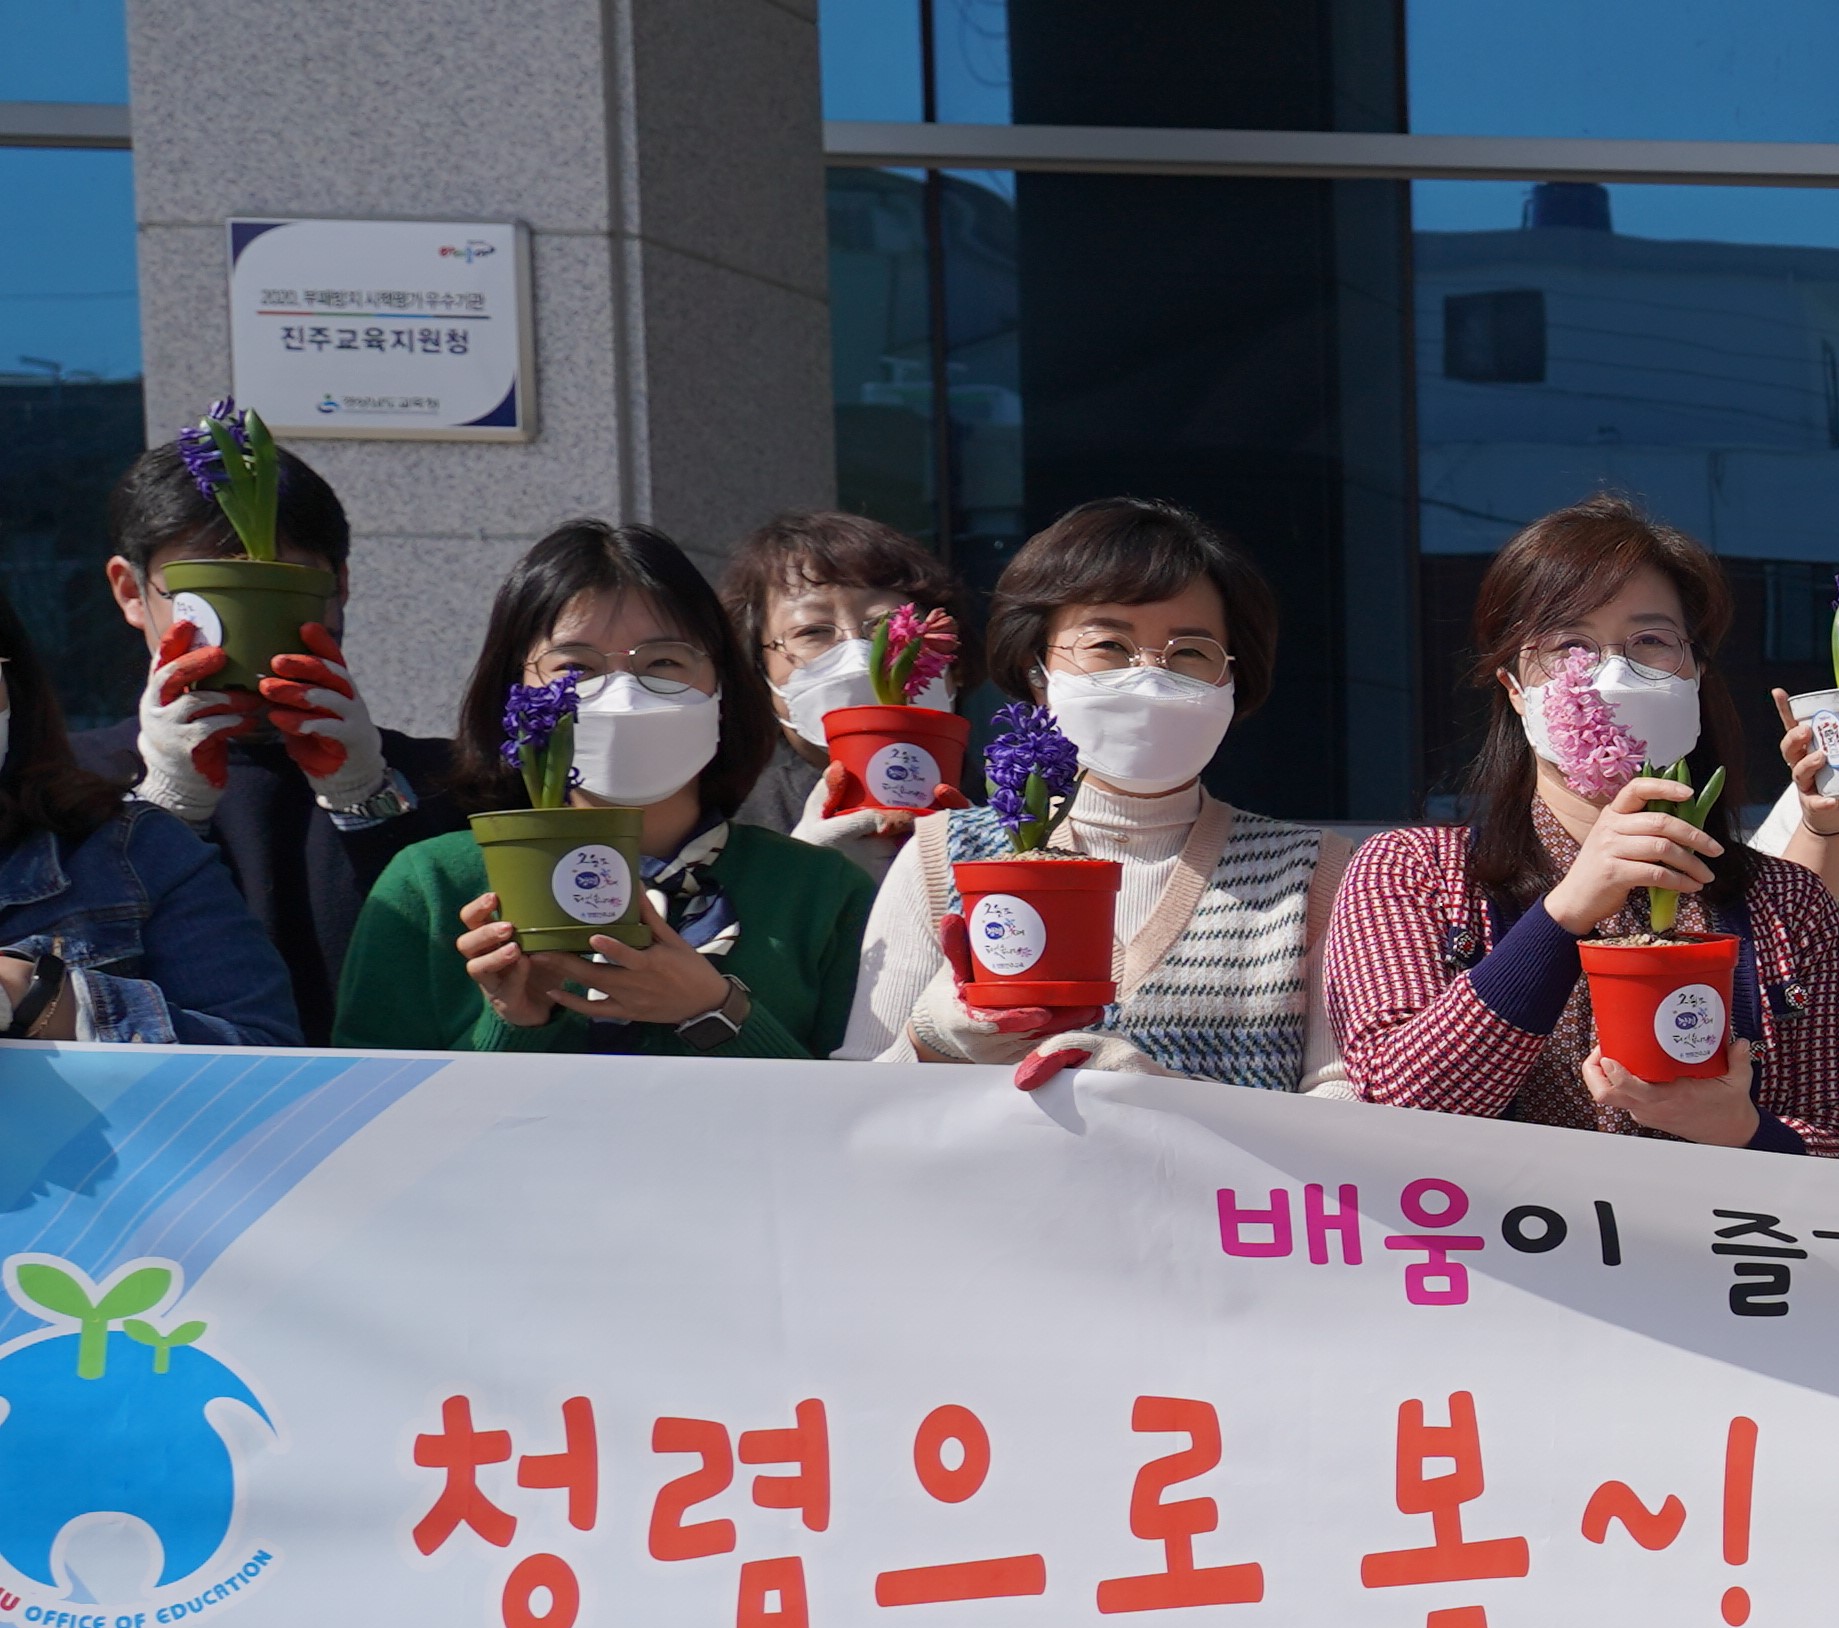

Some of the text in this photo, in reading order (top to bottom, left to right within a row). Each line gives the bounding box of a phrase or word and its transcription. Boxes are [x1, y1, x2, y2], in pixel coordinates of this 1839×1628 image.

[426, 292, 485, 311] 우수기관
[281, 325, 470, 355] 진주교육지원청
[1217, 1178, 1621, 1305] 배움이
[155, 1549, 273, 1624] EDUCATION
